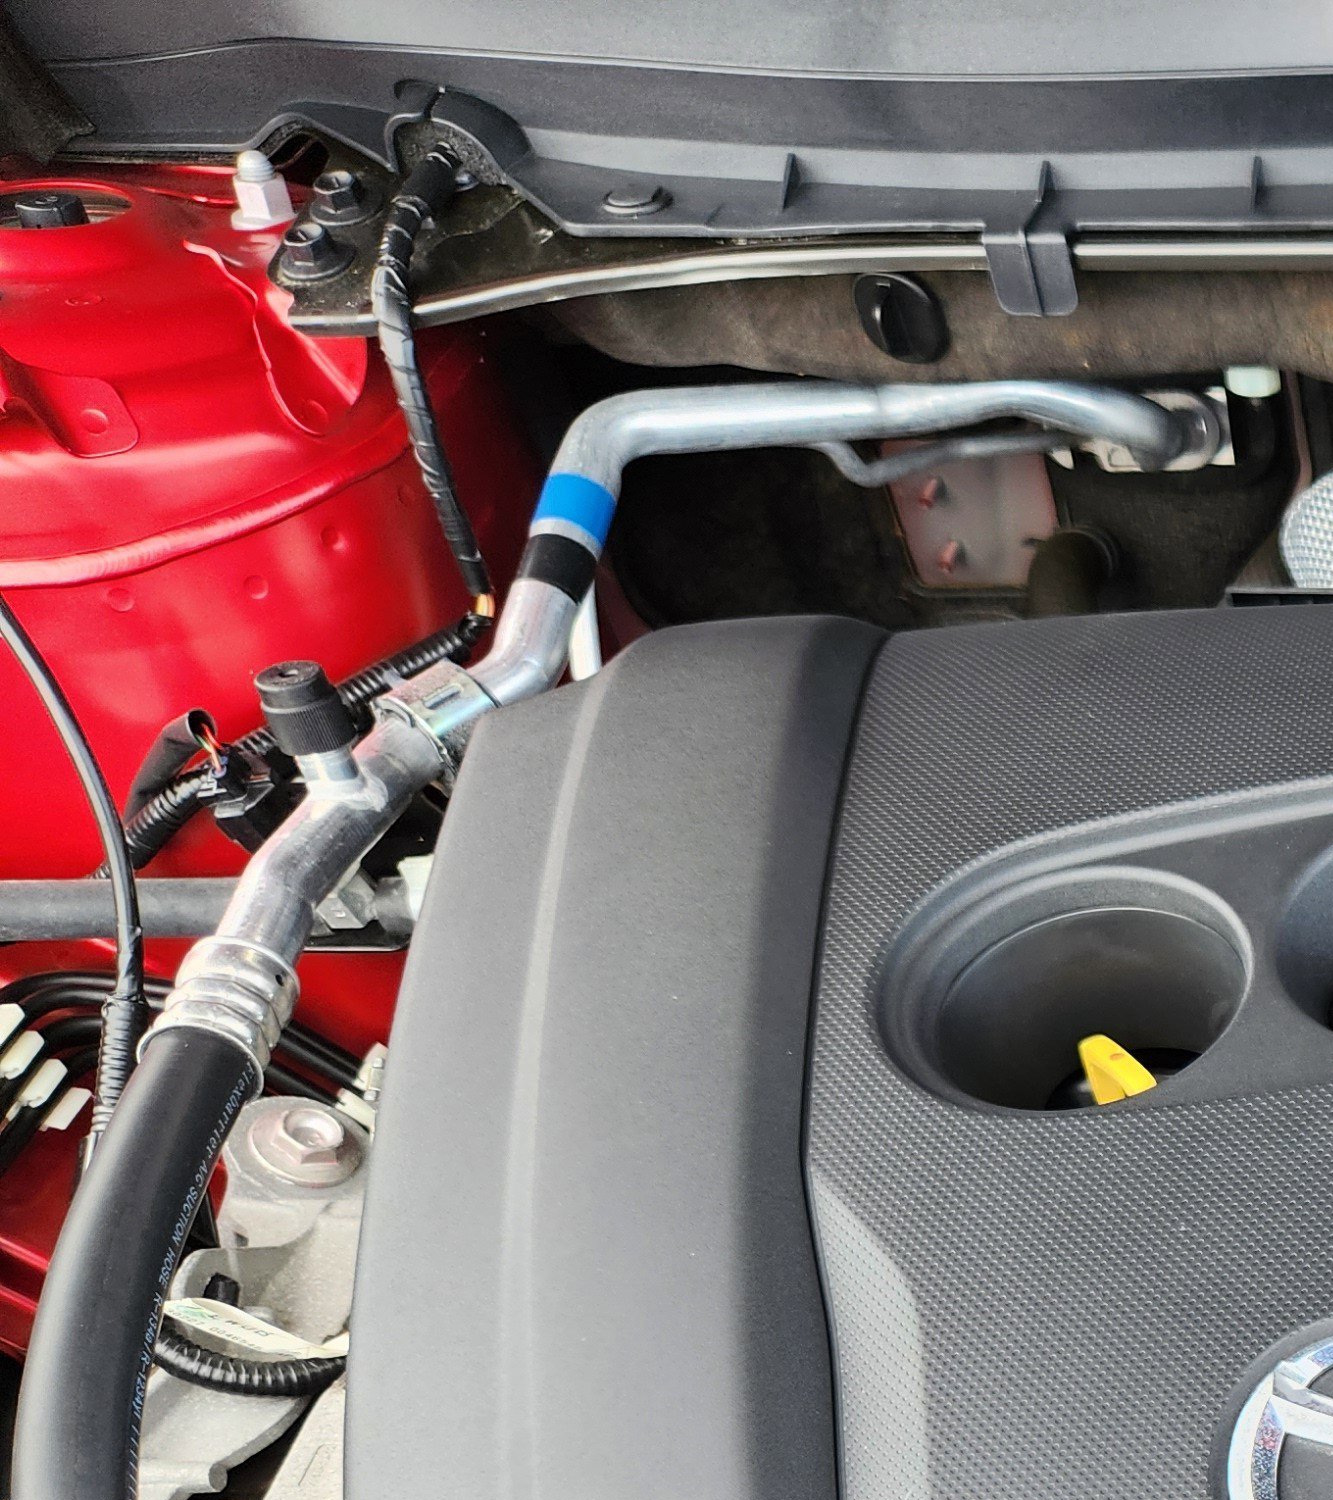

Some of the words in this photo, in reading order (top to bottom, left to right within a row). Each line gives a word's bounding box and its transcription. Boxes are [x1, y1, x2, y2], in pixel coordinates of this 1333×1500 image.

[206, 1061, 256, 1158] Flexbarrier
[195, 1159, 208, 1187] A/C
[172, 1186, 199, 1245] SUCTION
[158, 1247, 176, 1289] HOSE
